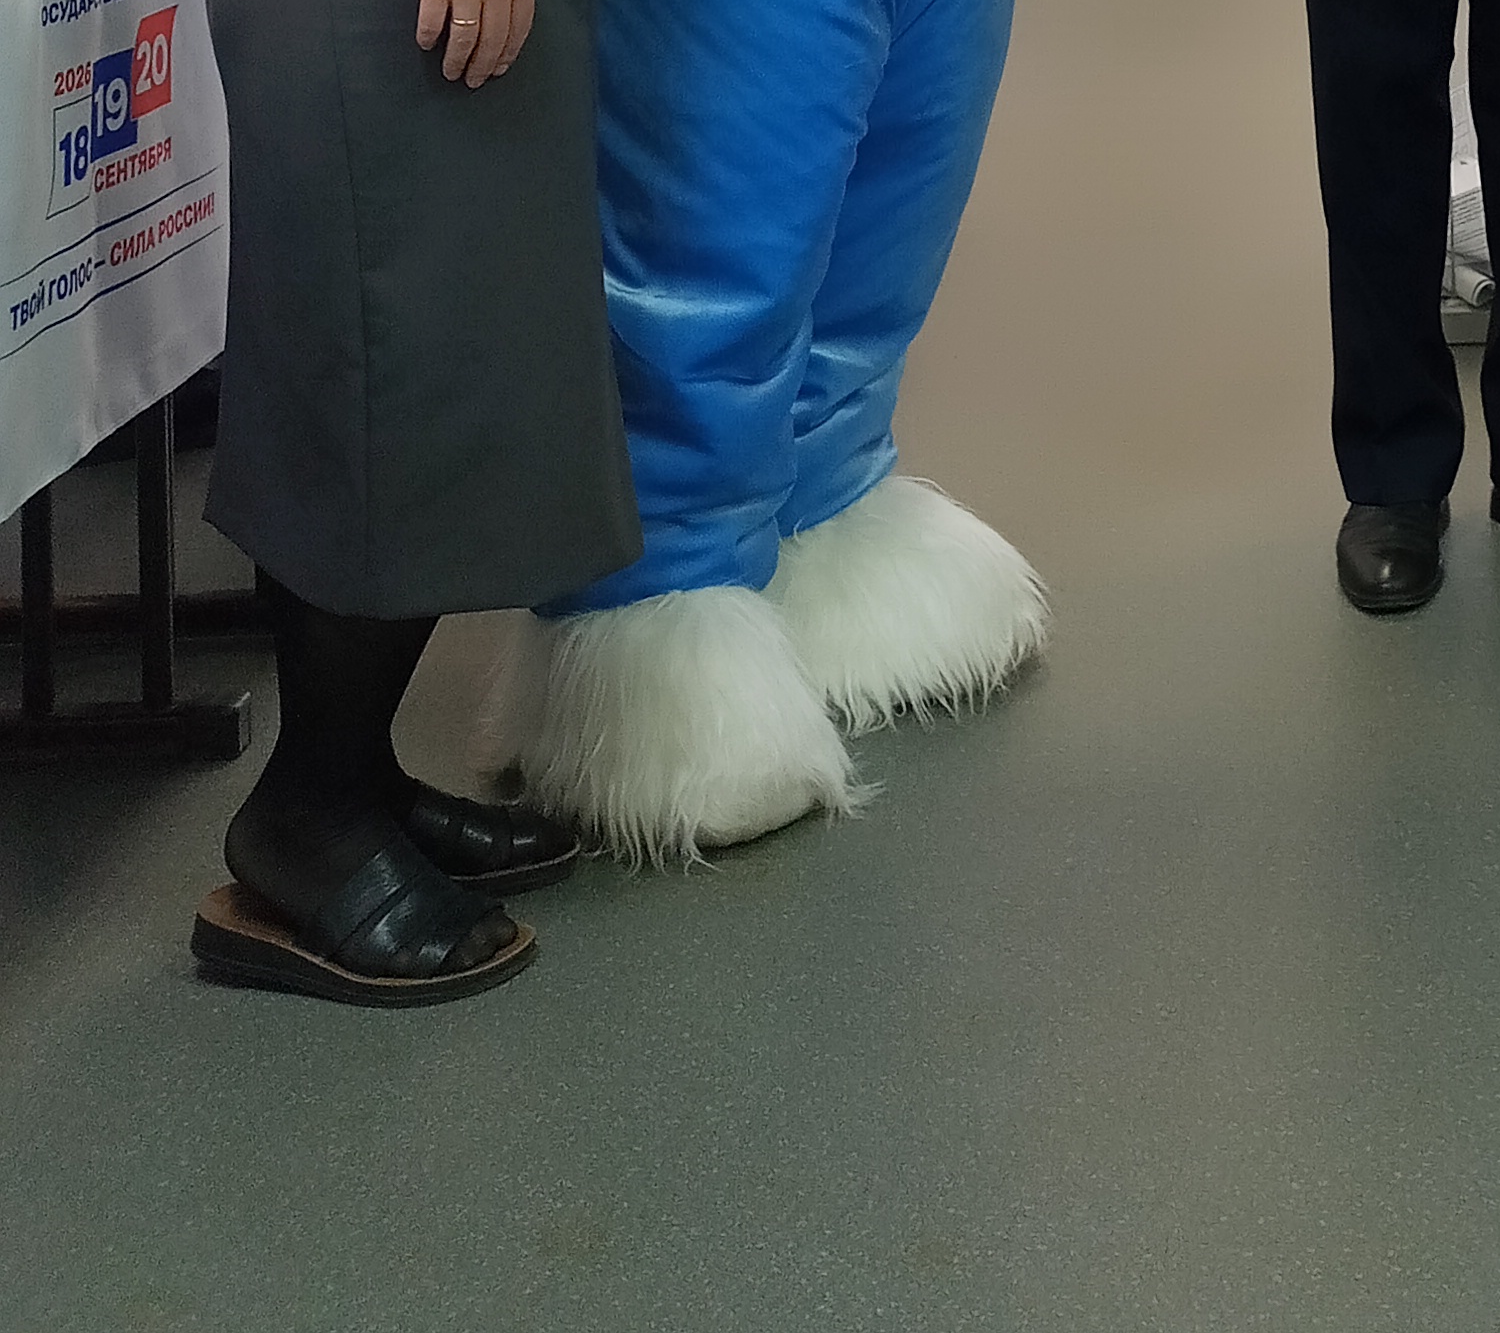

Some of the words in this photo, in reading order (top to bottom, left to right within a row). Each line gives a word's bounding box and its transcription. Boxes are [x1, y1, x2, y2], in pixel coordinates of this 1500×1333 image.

[54, 61, 91, 97] 2026
[134, 33, 169, 95] 20
[93, 76, 129, 138] 19
[59, 124, 90, 187] 18
[93, 137, 173, 193] СЕНТЯБРЯ
[9, 279, 46, 331] ТВОЙ
[47, 257, 93, 306] ГОЛОС
[110, 231, 156, 267] СИЛА
[157, 192, 215, 244] РОССИИ!
